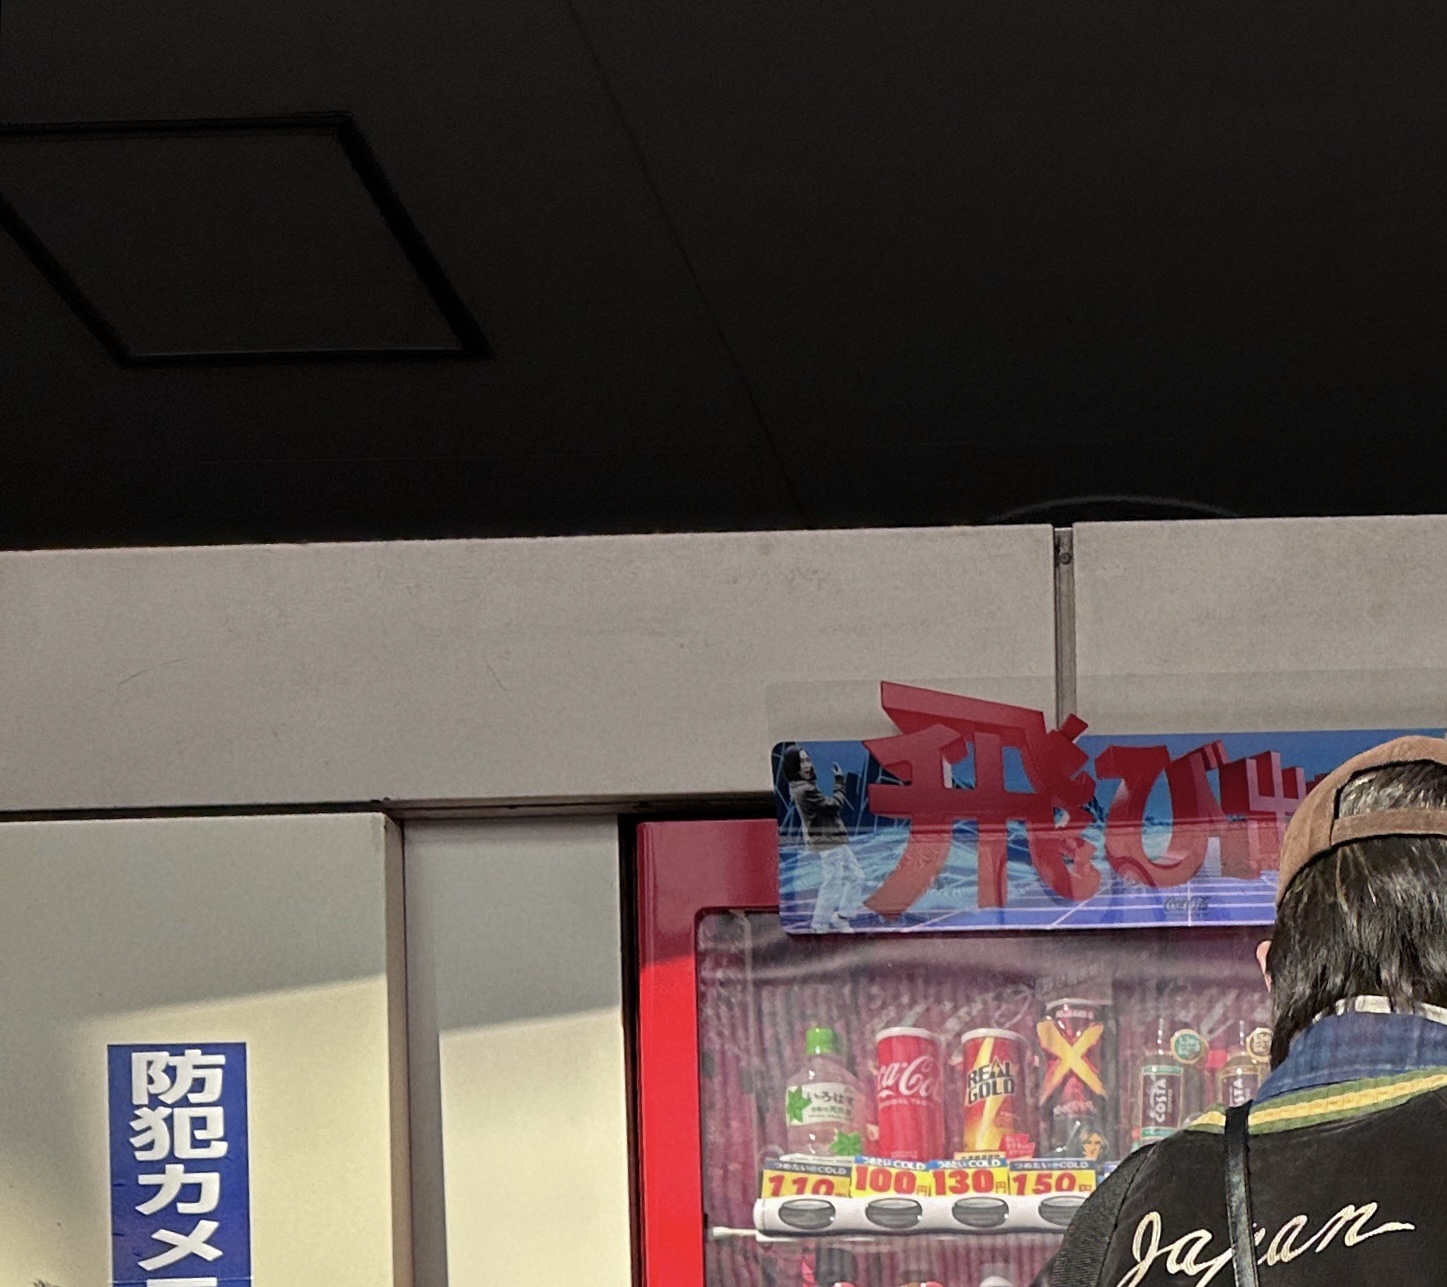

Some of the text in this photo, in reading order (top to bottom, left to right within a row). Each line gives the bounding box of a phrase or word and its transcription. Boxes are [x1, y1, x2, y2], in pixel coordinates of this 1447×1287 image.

[968, 1058, 1015, 1083] REAL
[967, 1080, 1015, 1105] GOLD
[1153, 1077, 1167, 1123] COSTA
[893, 1159, 926, 1170] COLD
[967, 1158, 1001, 1168] COLD
